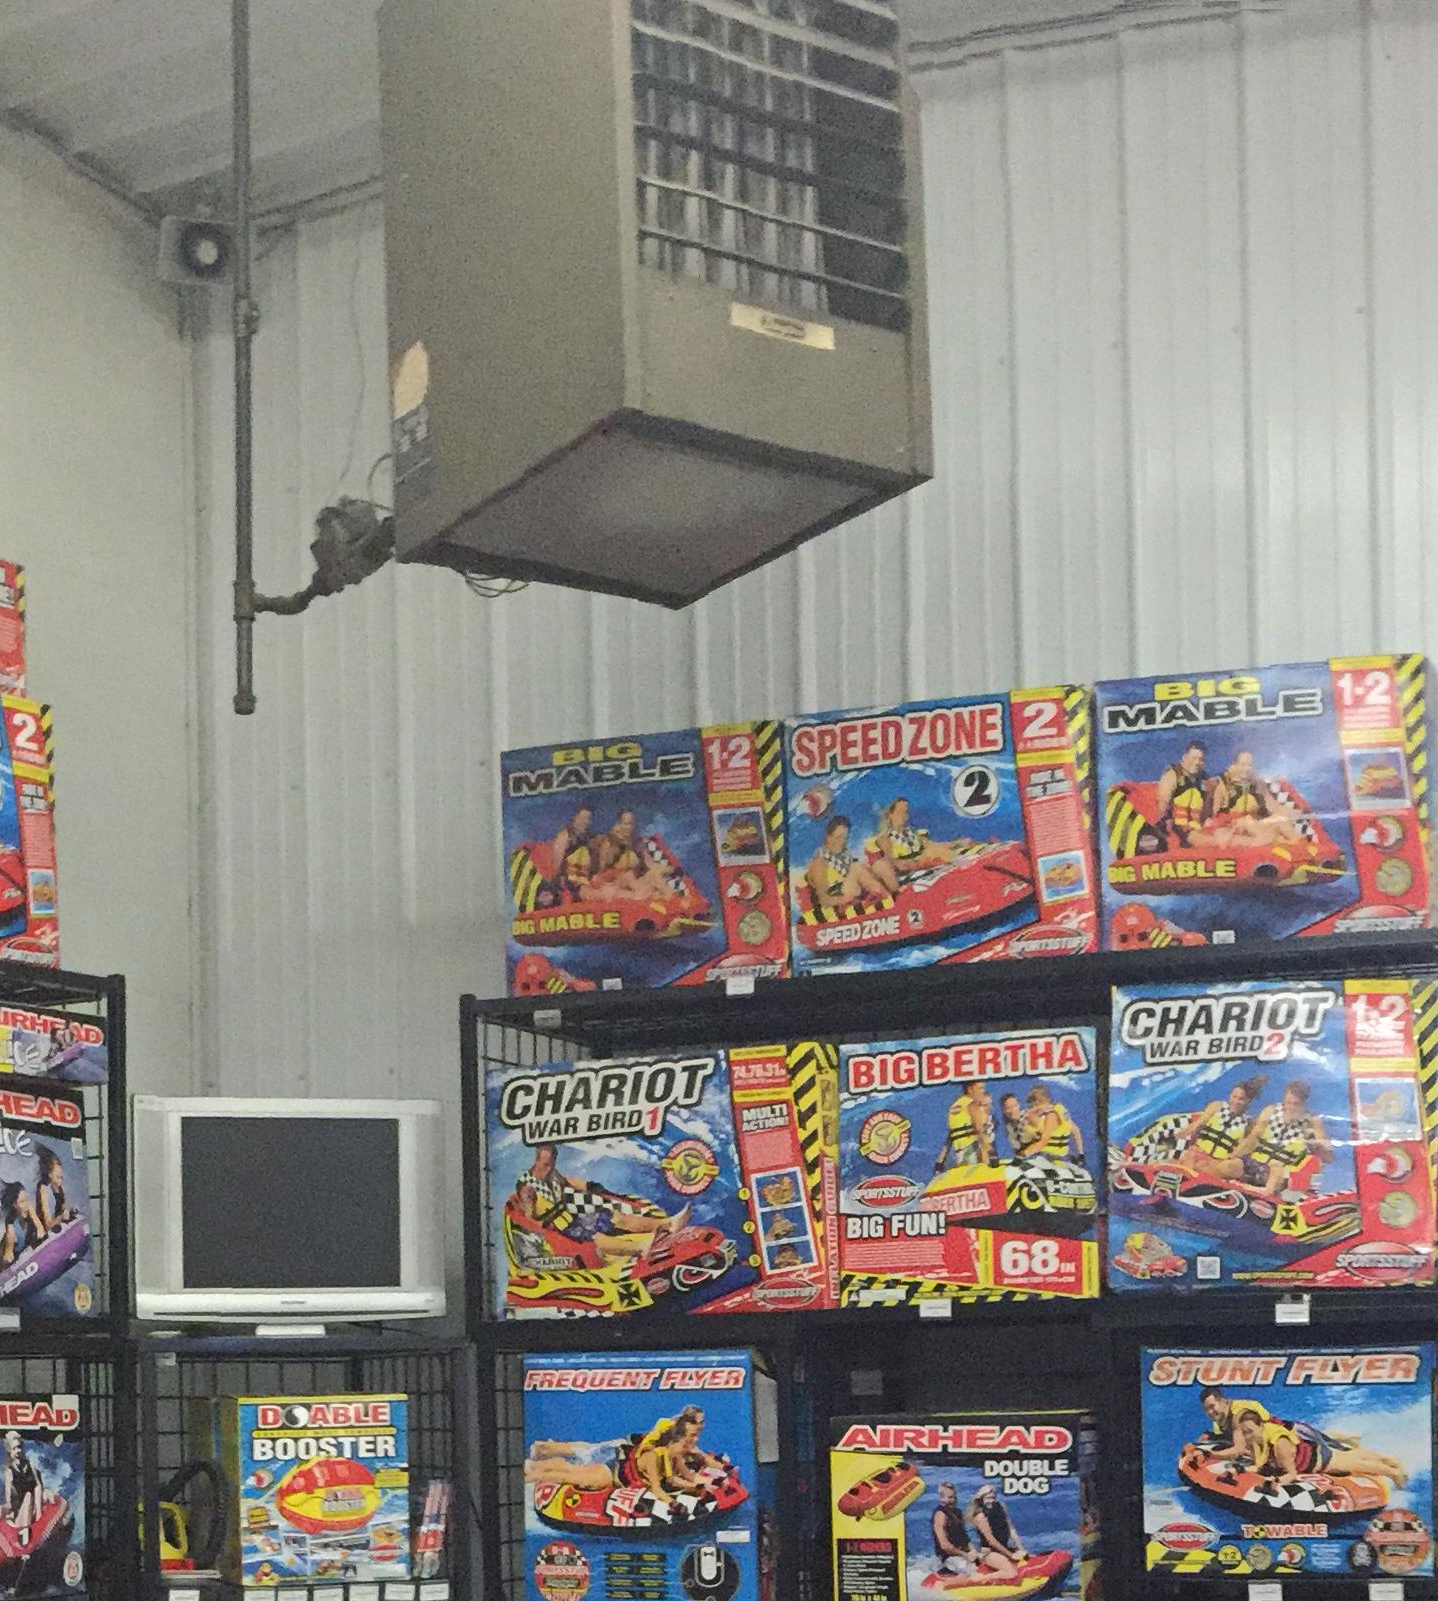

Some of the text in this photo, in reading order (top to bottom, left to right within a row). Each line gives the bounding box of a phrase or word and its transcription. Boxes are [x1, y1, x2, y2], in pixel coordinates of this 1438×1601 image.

[1153, 675, 1260, 701] BIG
[1022, 702, 1058, 737] 2
[1103, 687, 1323, 733] MABLE
[10, 713, 39, 749] 2
[552, 742, 642, 765] BIG
[509, 753, 695, 797] MABLE
[963, 770, 991, 808] 2
[1122, 989, 1335, 1046] CHARIOT
[849, 1033, 1088, 1093] BIG BERTHA
[503, 1058, 714, 1128] CHARIOT
[846, 1212, 946, 1239] BIG FUN!
[524, 1367, 746, 1392] FREQUENT FLYER
[1148, 1353, 1421, 1386] STUNT FLYER
[253, 1436, 396, 1460] BOOSTER
[837, 1423, 1073, 1454] AIRHEAD
[983, 1459, 1070, 1478] DOUBLE
[1003, 1477, 1050, 1495] DOG
